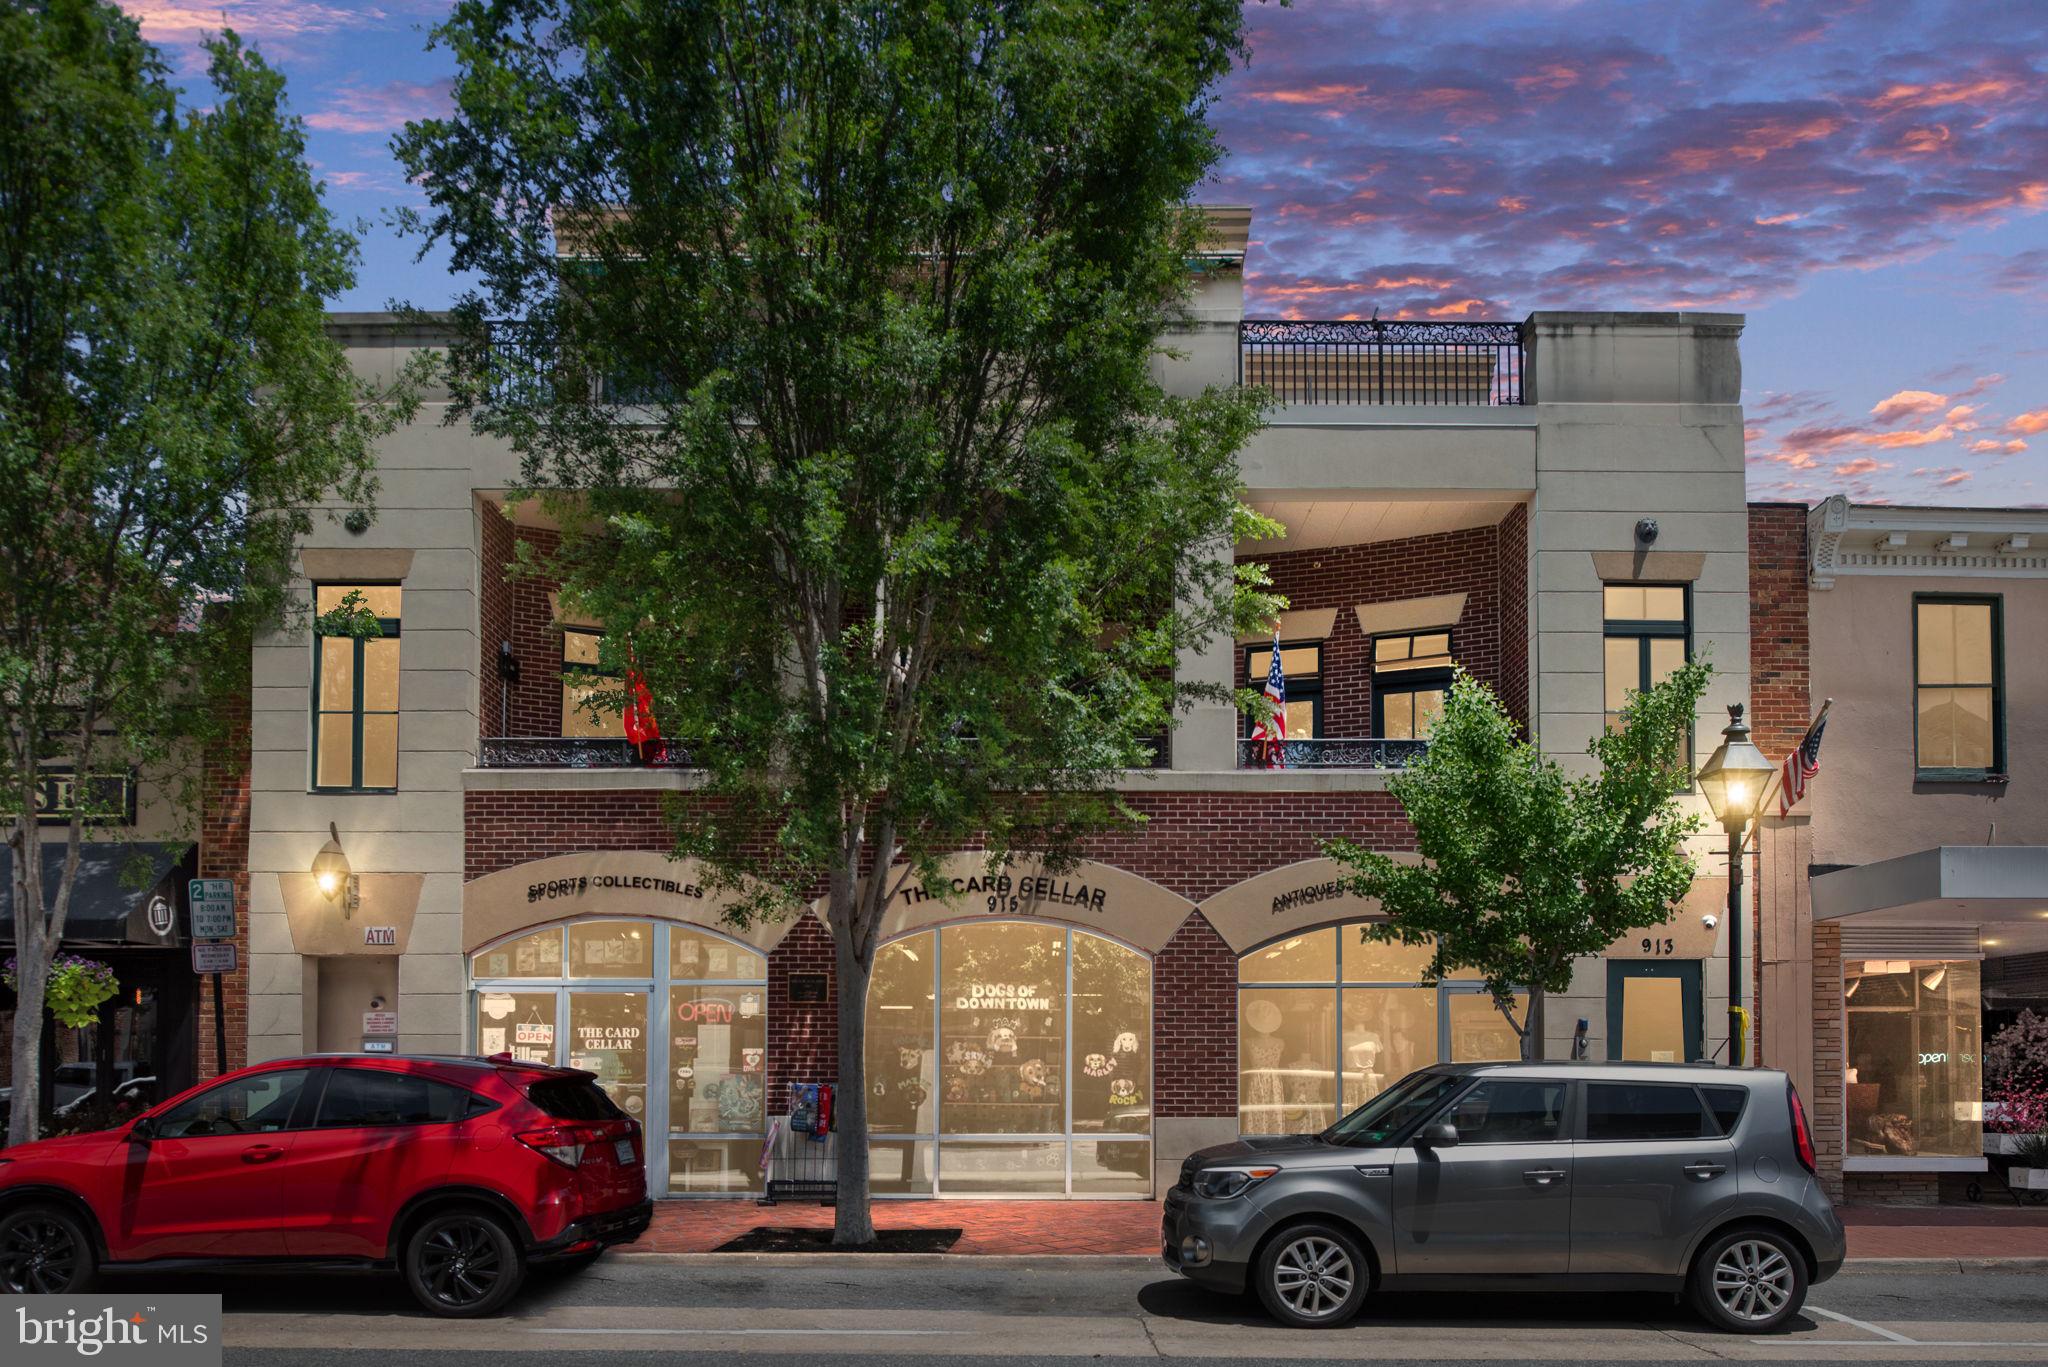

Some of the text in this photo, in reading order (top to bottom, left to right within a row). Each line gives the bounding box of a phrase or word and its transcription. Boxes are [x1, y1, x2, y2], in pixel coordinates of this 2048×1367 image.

[192, 884, 202, 898] 2
[528, 876, 703, 899] SPORTS COLLECTIBLES
[900, 876, 1106, 905] TH CARD CELLAR
[1273, 880, 1345, 907] ANTIQUES
[987, 895, 1019, 913] 915
[366, 929, 395, 943] ATM
[1642, 938, 1673, 955] 913
[971, 983, 1038, 998] DOGS OF
[956, 997, 1050, 1010] DOWNTOWN
[678, 1003, 733, 1023] OPEN
[517, 1032, 552, 1042] OPEN
[577, 1027, 640, 1038] THE CARD
[585, 1039, 632, 1050] CELLAR
[1918, 1053, 1947, 1065] open
[1083, 1057, 1118, 1077] HARLEY
[1109, 1089, 1144, 1105] ROCKY
